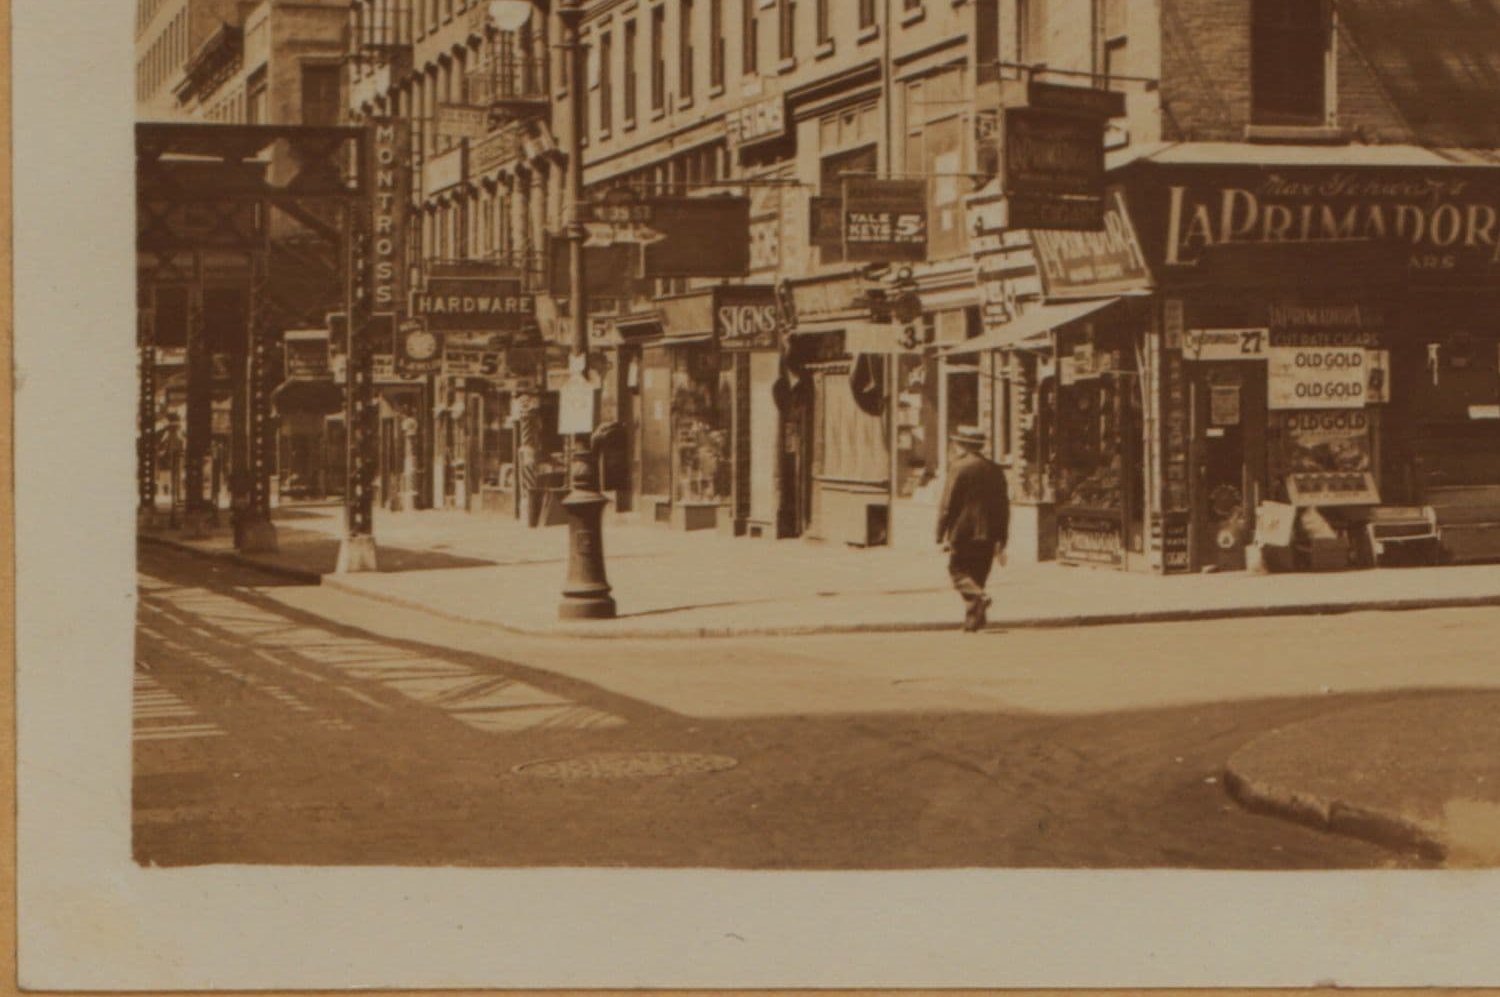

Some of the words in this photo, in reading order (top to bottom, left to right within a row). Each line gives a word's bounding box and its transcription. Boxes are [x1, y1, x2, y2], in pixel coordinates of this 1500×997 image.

[375, 125, 395, 303] MONTROSS
[849, 213, 890, 223] YALE
[849, 224, 890, 236] KEYS
[419, 296, 533, 314] HARDWARE
[719, 306, 776, 340] SIGNS
[1295, 353, 1321, 367] OLD
[1324, 353, 1362, 368] GOLD
[1295, 382, 1321, 397] OLD
[1324, 382, 1362, 398] GOLD
[1286, 415, 1319, 431] OLD
[1321, 414, 1366, 430] GOLD
